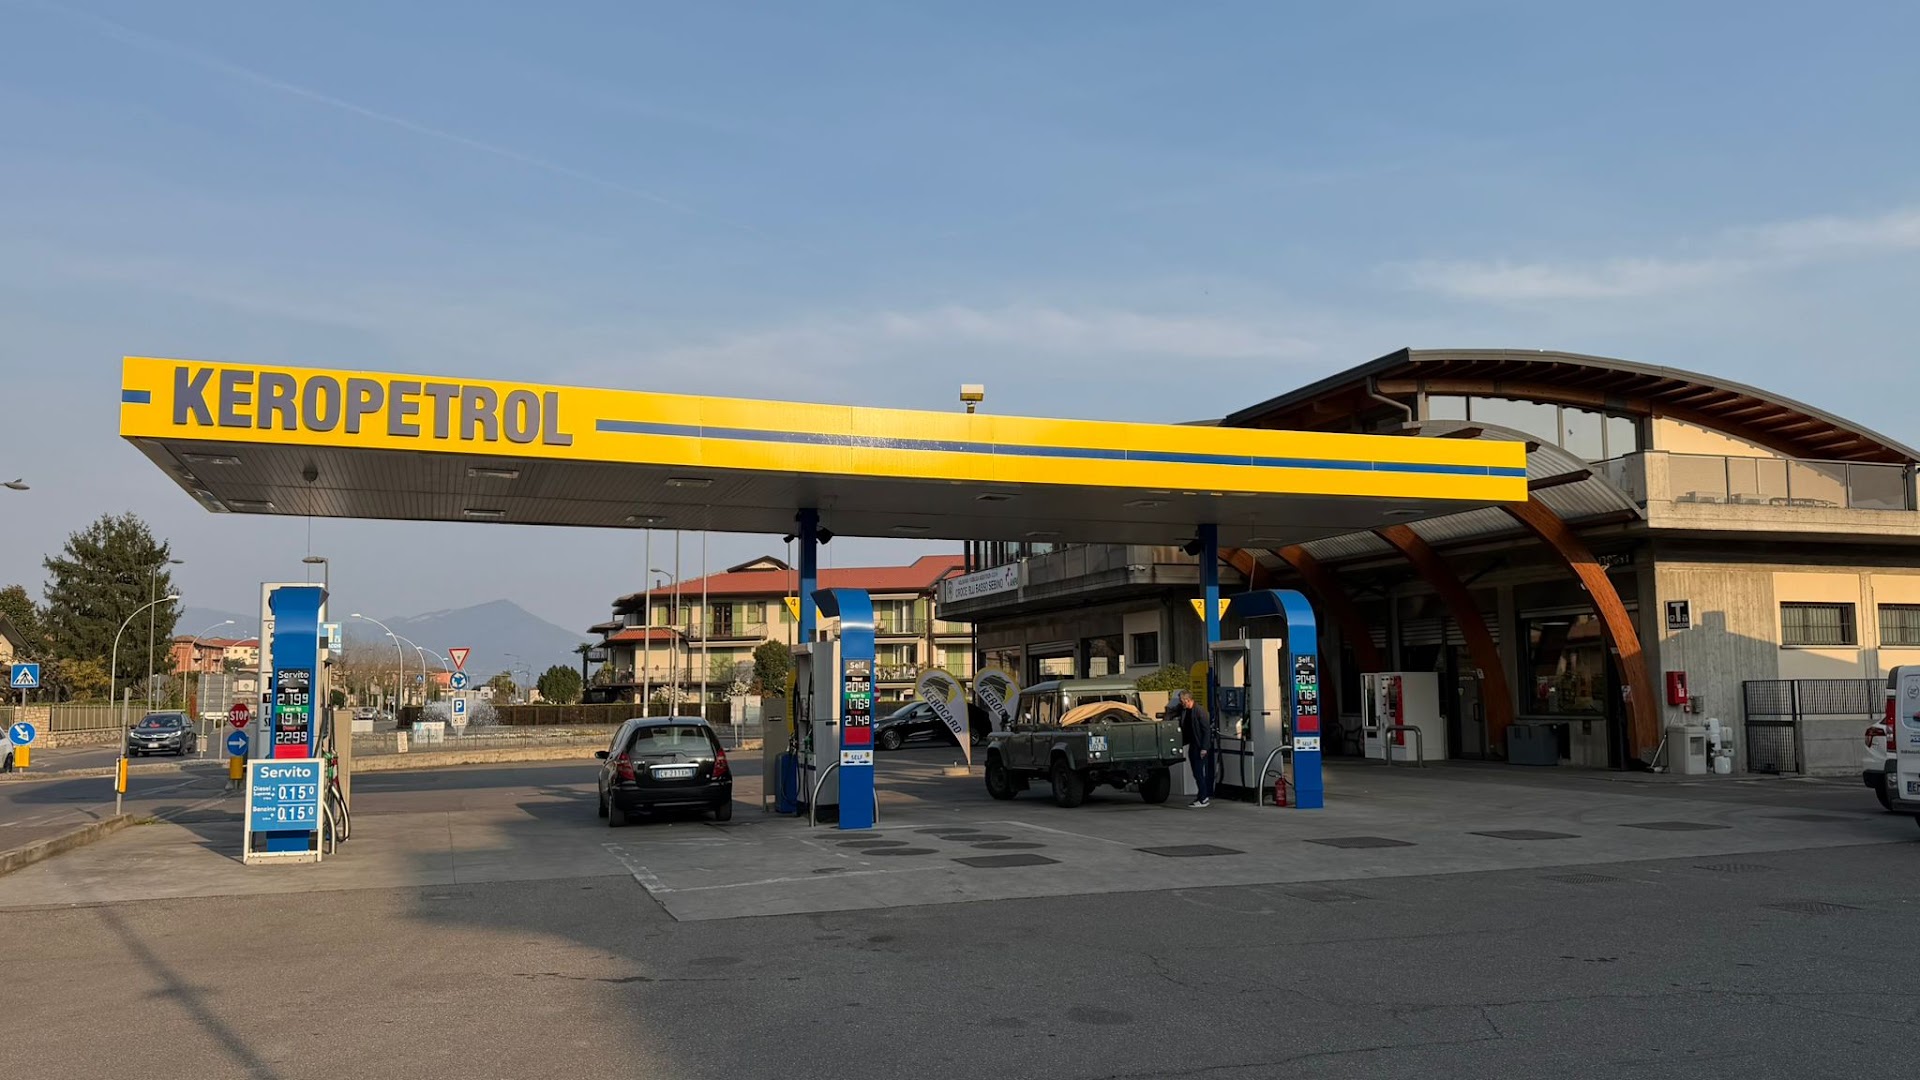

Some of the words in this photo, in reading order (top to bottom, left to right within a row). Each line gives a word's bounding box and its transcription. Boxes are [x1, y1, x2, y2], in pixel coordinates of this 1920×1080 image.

[173, 366, 573, 446] KEROPETROL
[791, 599, 796, 607] 4
[1670, 602, 1685, 622] T
[849, 661, 865, 669] Self
[278, 670, 310, 679] Servito
[456, 701, 462, 712] P
[922, 688, 962, 734] KEROCARD
[230, 710, 248, 720] STOP
[260, 766, 311, 778] Servito
